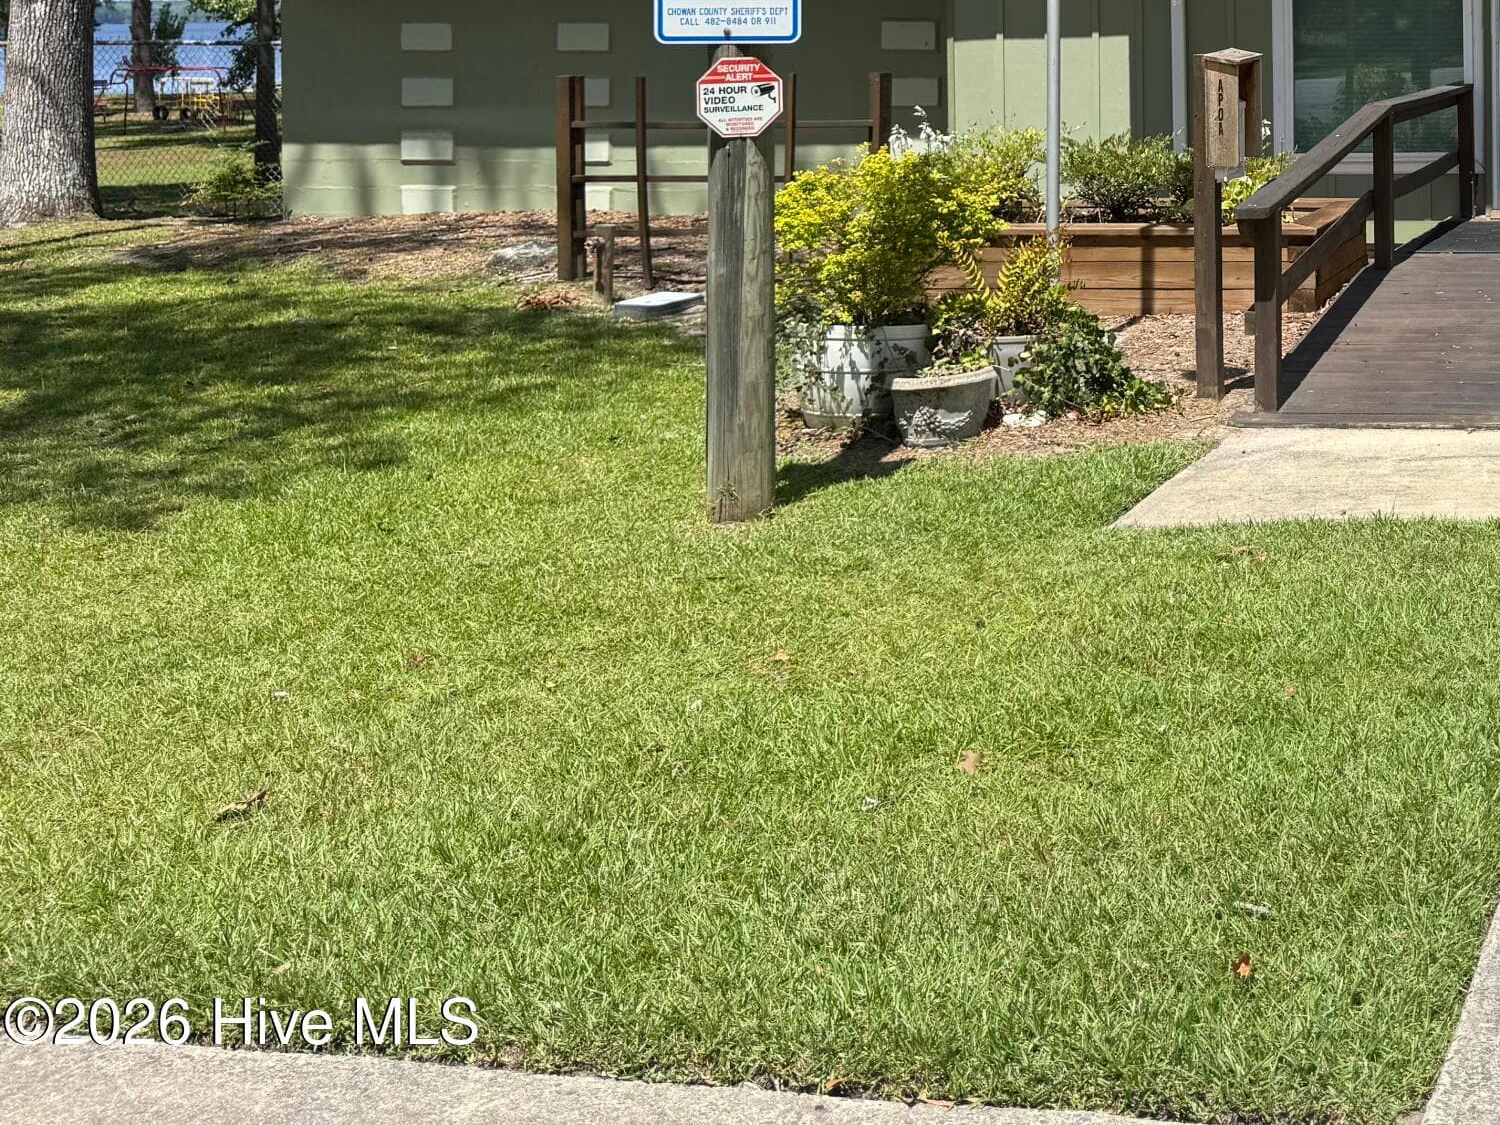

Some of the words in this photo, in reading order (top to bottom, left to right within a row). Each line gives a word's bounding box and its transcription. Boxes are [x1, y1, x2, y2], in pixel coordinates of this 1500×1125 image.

[667, 7, 696, 16] CHOWAN
[699, 7, 727, 16] COUNTY
[769, 7, 788, 16] DEPT
[680, 17, 700, 26] CALL
[705, 17, 748, 26] 482-8484
[751, 17, 762, 26] OR
[765, 17, 776, 26] 911
[717, 63, 760, 73] SECURITY
[725, 73, 753, 81] ALERT
[703, 87, 715, 95] 24
[719, 86, 747, 94] HOUR
[704, 96, 736, 105] VIDEO
[704, 105, 764, 113] SURVEILLANCE
